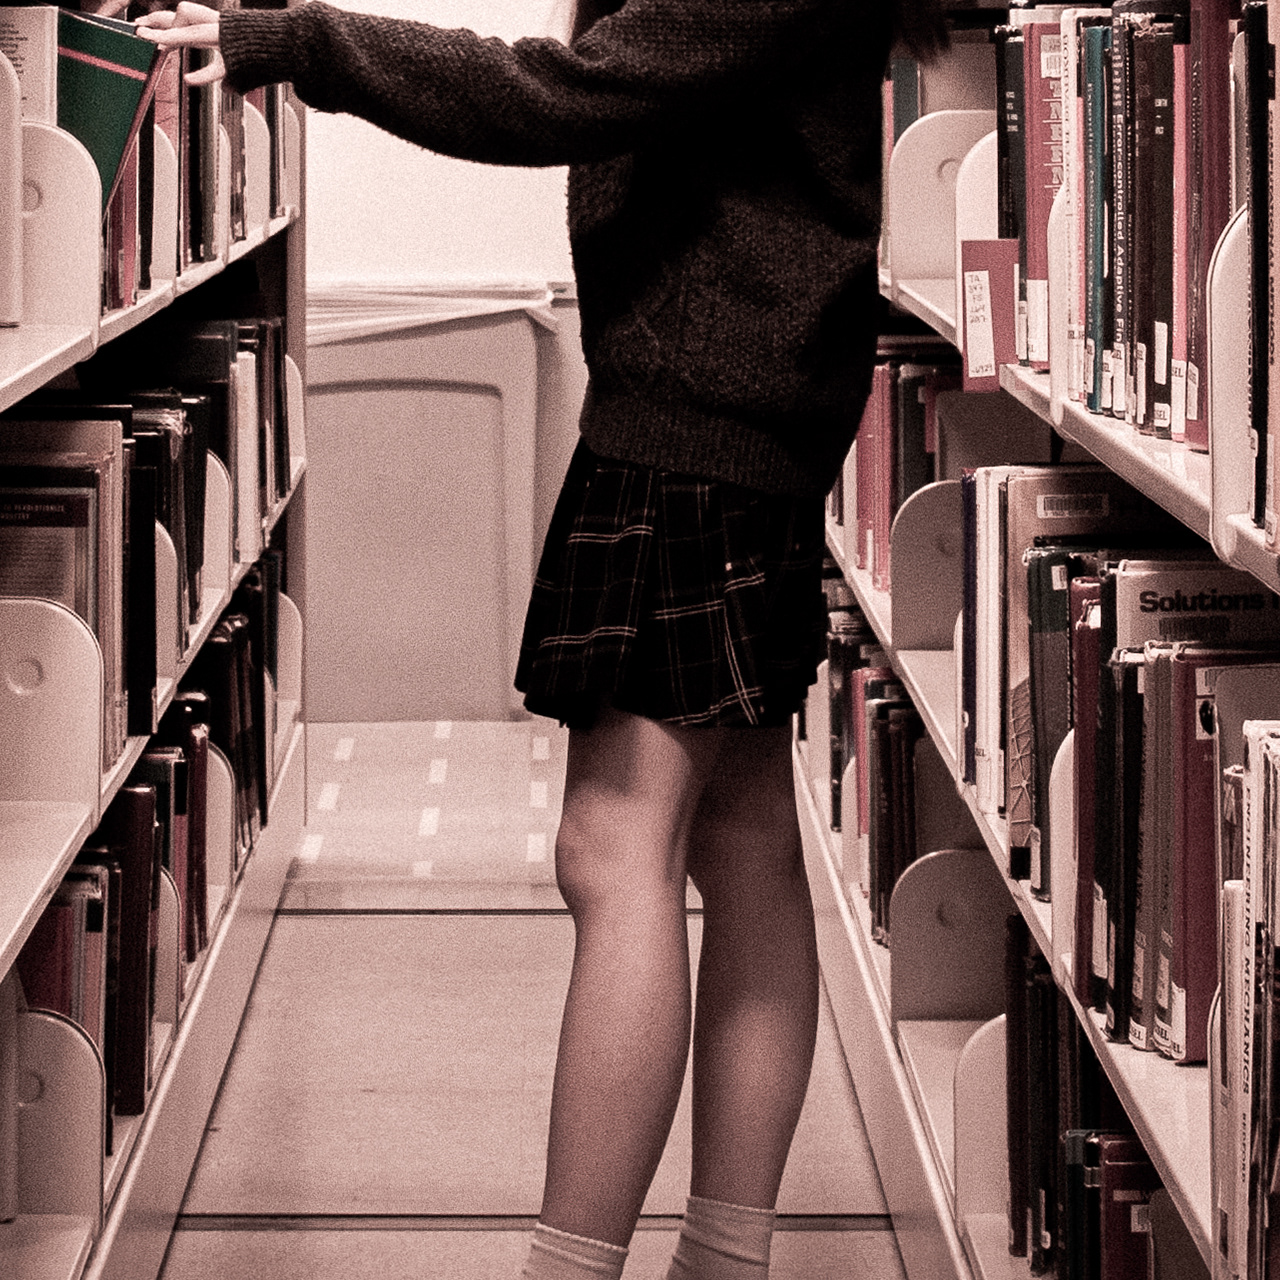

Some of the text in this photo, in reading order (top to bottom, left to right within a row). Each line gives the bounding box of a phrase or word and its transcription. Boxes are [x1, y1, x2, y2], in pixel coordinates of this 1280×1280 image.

[1116, 112, 1124, 240] Error-controlled
[1116, 244, 1124, 313] Adaptive
[1139, 588, 1265, 613] Solutions
[1244, 787, 1252, 948] ENGINEERING
[1242, 956, 1251, 1095] MECHANICS
